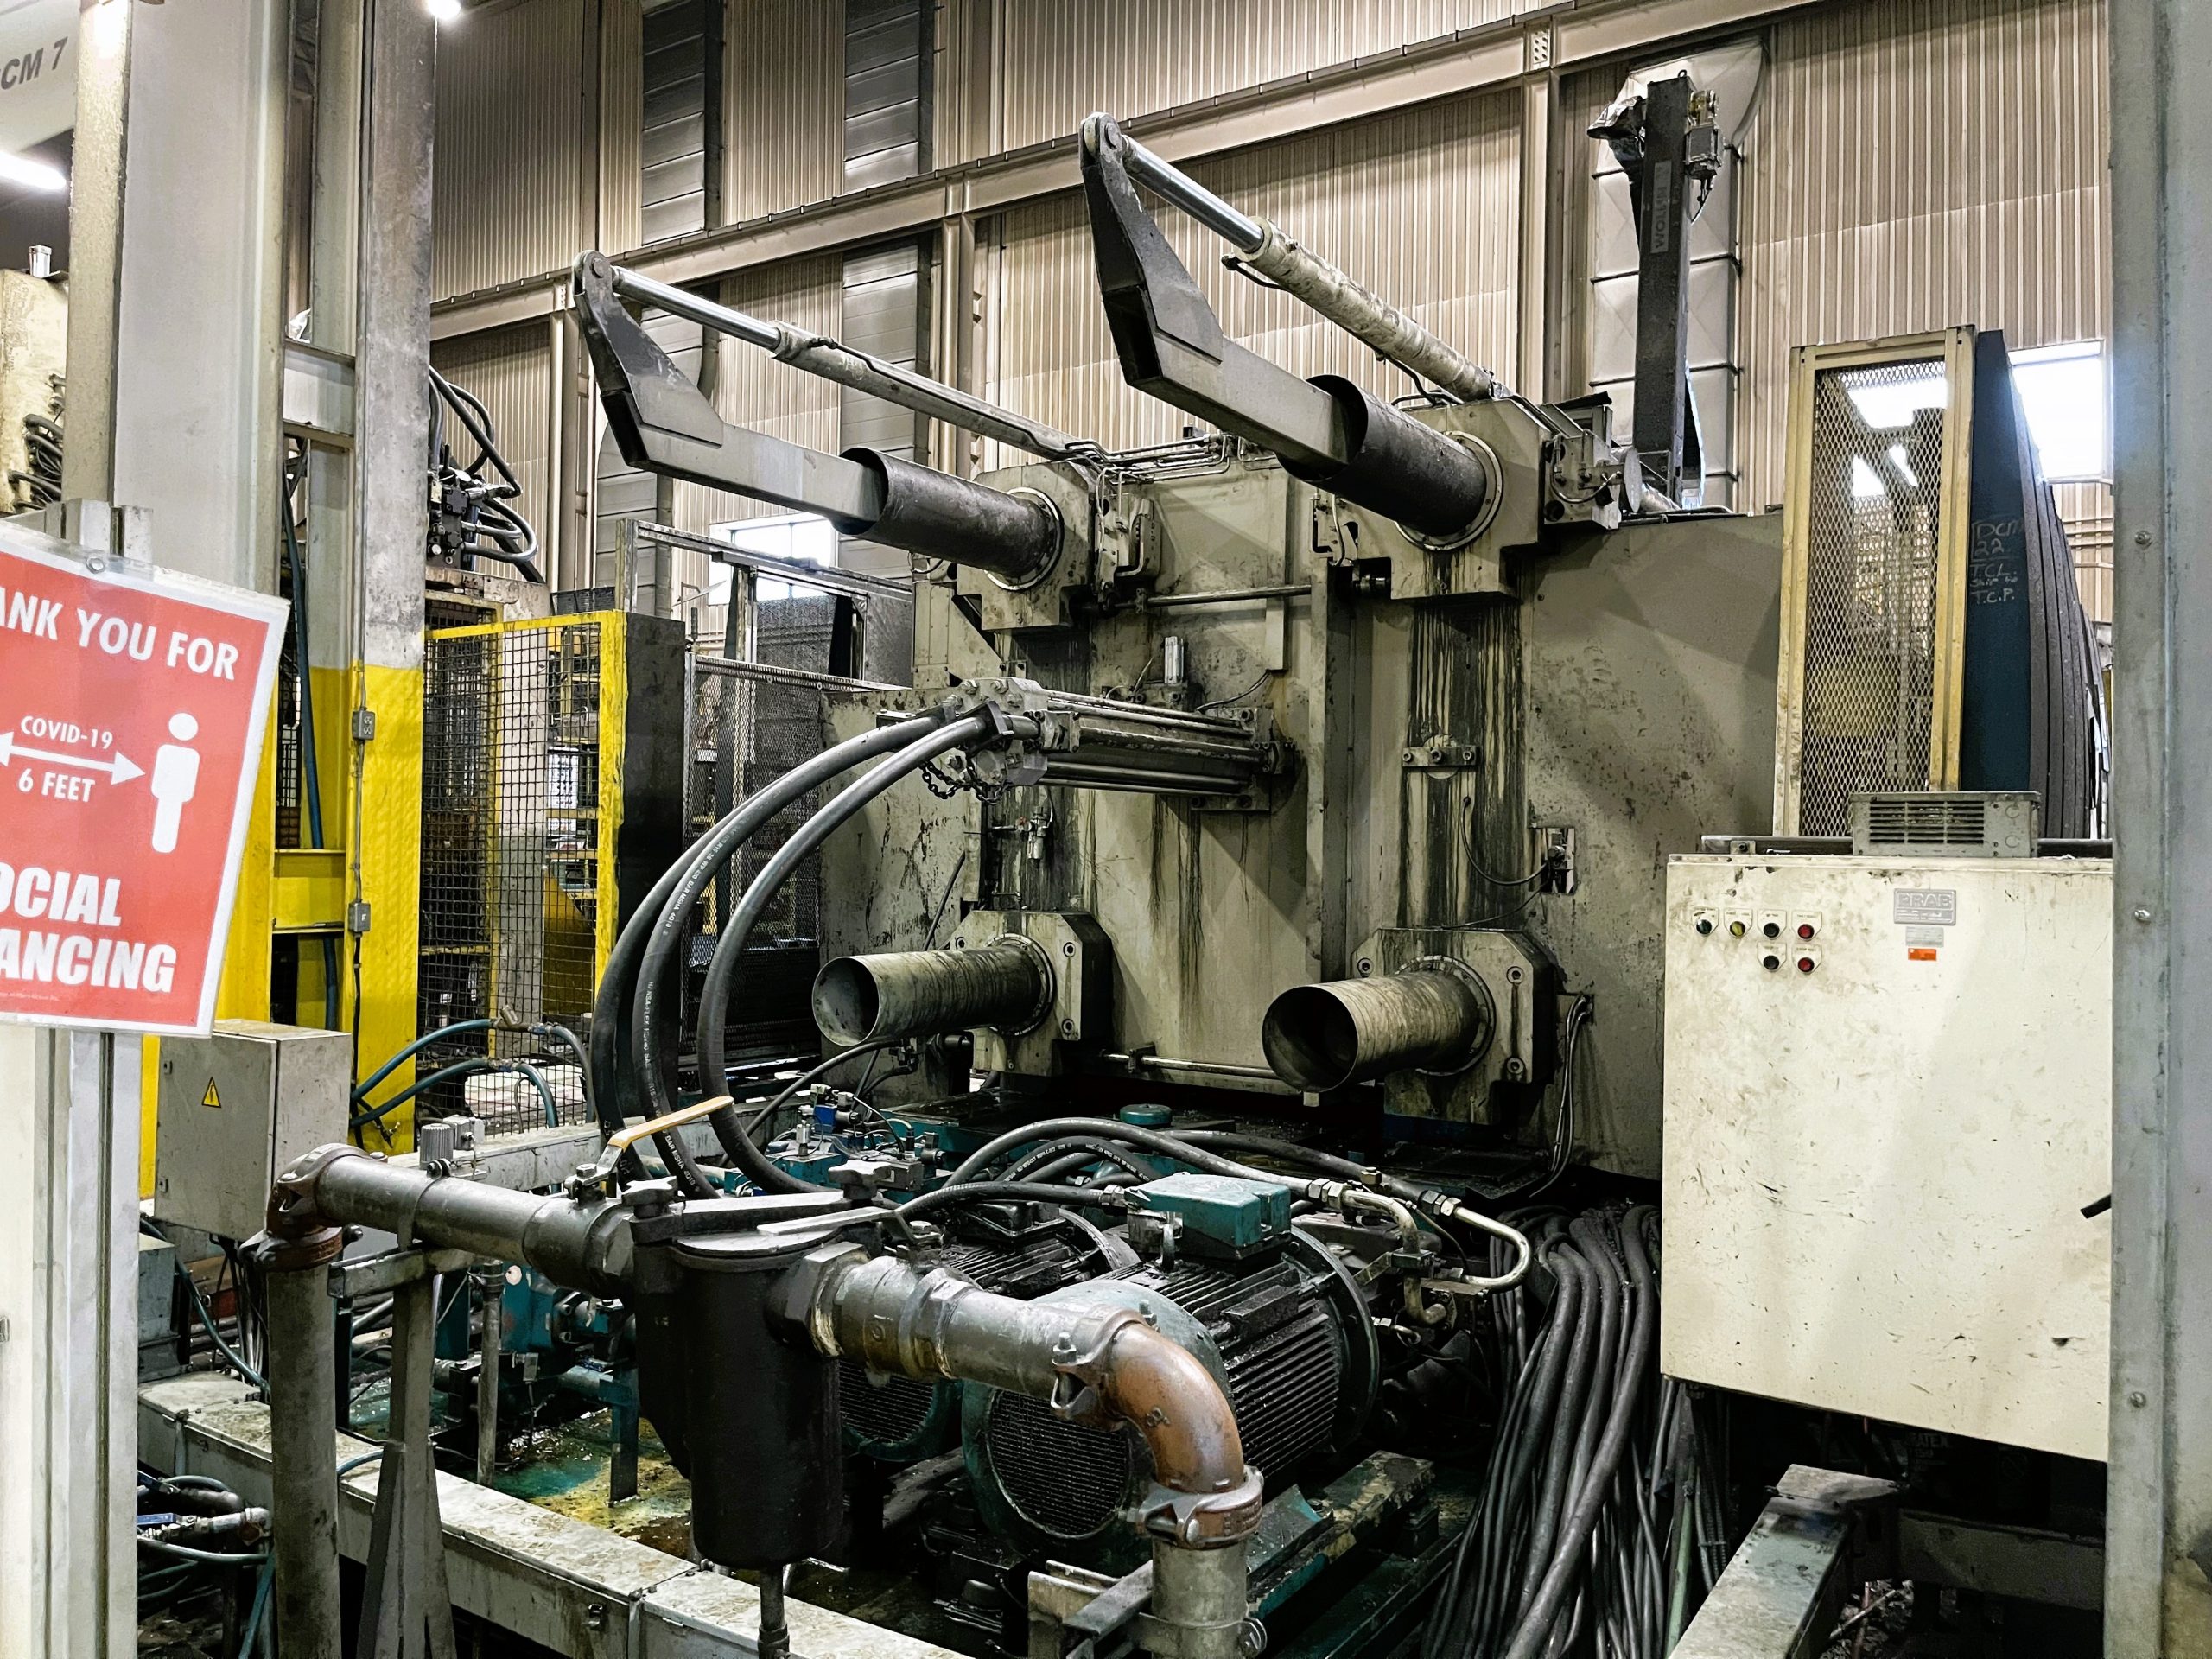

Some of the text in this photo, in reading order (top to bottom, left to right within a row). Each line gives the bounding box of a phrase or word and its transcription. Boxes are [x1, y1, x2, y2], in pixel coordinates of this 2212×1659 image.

[52, 35, 68, 71] 7
[1974, 538, 2005, 556] 22
[0, 588, 238, 681] NK YOU FOR
[21, 715, 113, 749] COVID-19
[18, 768, 95, 803] 6 FEET
[671, 1149, 685, 1170] MSHA
